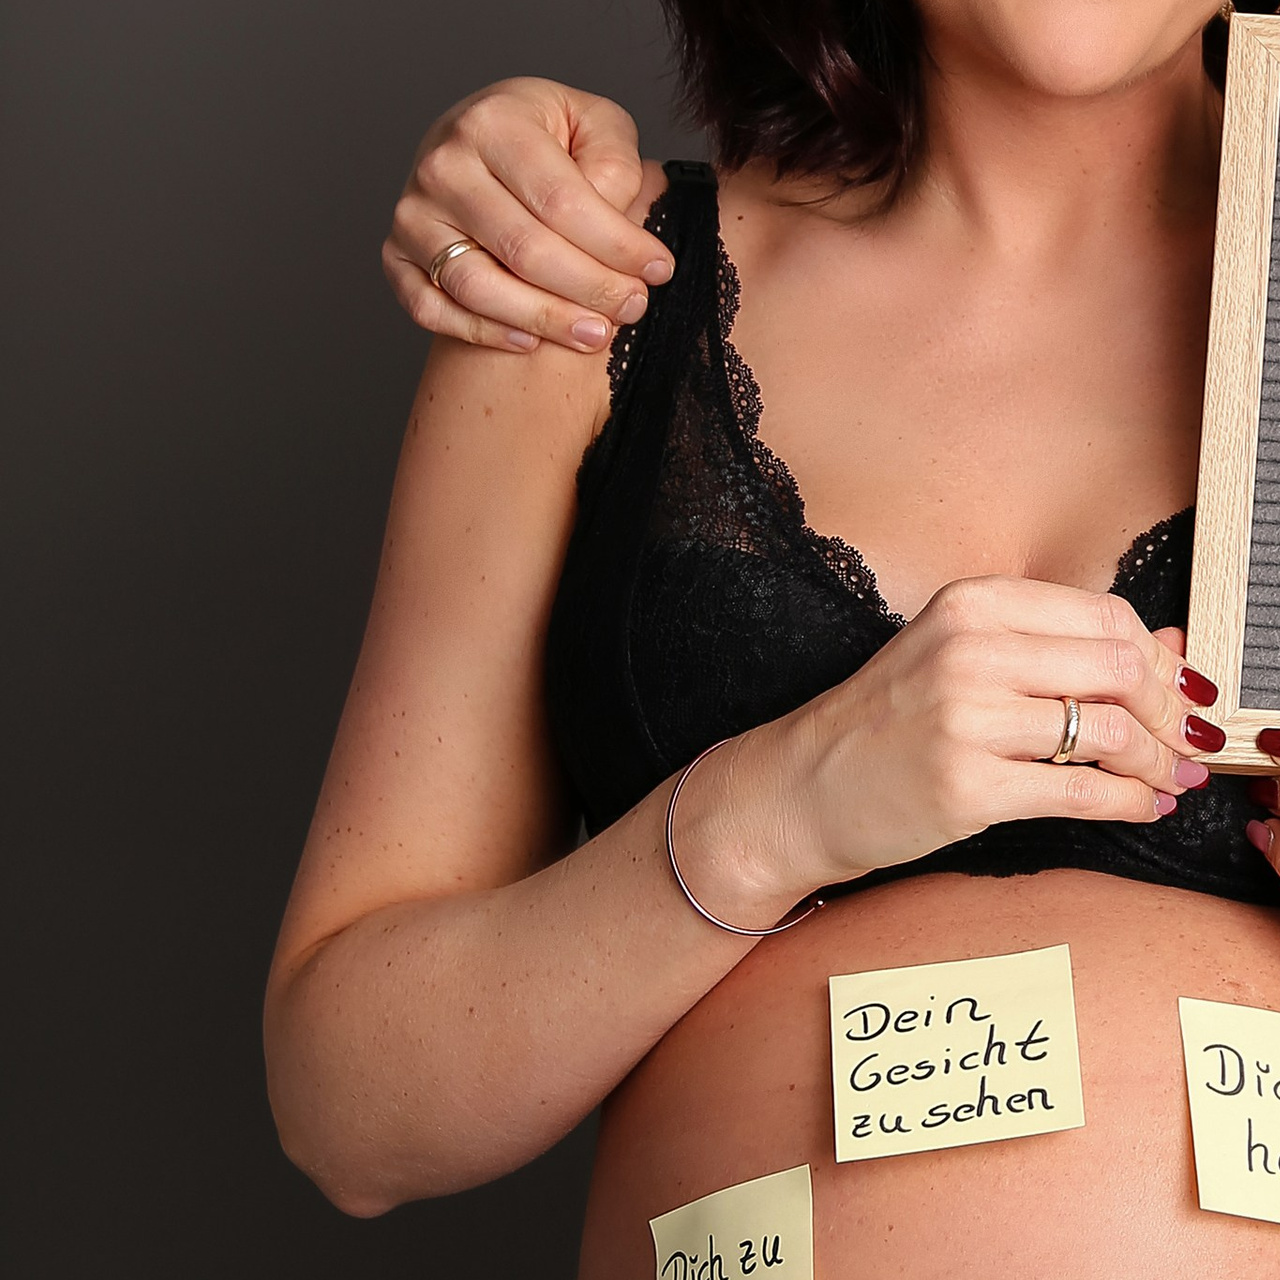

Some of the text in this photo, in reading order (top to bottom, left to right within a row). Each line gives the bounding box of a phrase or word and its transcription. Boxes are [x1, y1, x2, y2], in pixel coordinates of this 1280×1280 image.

[843, 997, 992, 1042] Dein
[849, 1019, 1051, 1093] Gesicht
[851, 1075, 1055, 1139] zu sehen
[739, 1235, 784, 1275] zu
